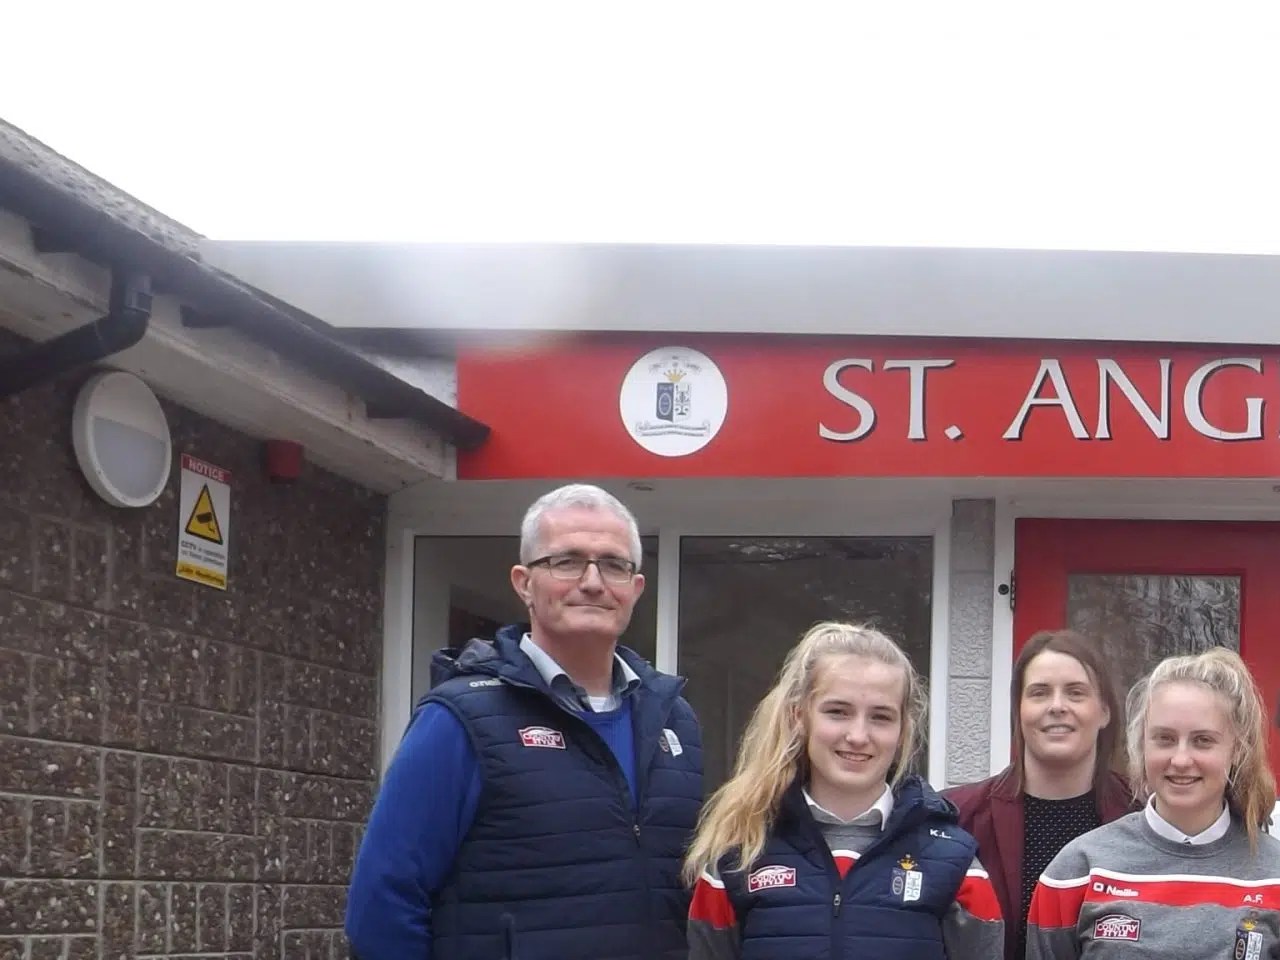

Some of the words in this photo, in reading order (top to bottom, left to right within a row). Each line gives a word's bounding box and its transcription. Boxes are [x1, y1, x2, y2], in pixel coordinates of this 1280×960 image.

[818, 357, 963, 442] ST.
[189, 458, 225, 482] NOTICE
[1097, 922, 1138, 934] COUNTRY
[1102, 929, 1128, 938] STYLE
